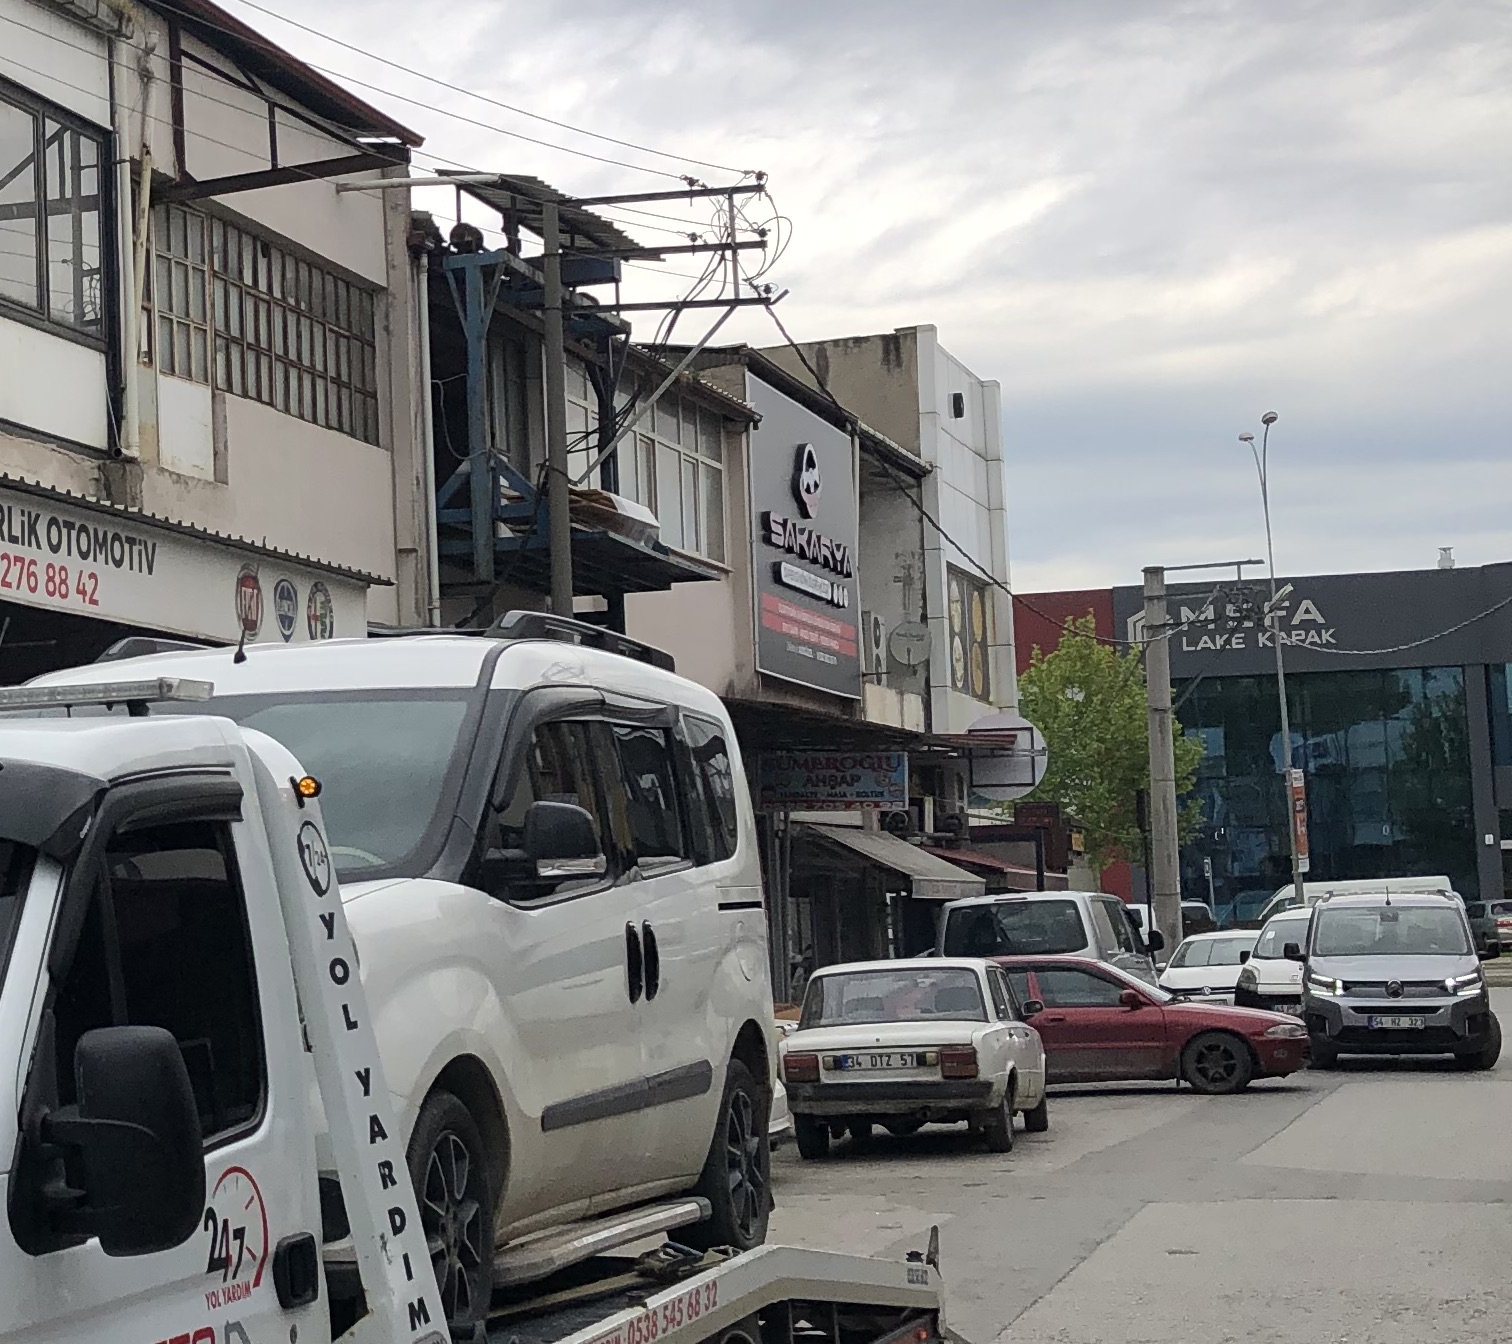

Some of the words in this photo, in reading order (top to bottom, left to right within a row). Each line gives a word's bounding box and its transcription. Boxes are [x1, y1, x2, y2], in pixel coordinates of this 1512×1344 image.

[768, 511, 852, 577] SAKARYA
[1, 553, 38, 594] 276
[45, 563, 69, 599] 88
[75, 572, 99, 607] 42
[1182, 633, 1245, 651] LAKE
[1258, 628, 1337, 647] KAPAK
[849, 1056, 862, 1069] 34
[900, 1053, 914, 1066] 57
[319, 911, 358, 1031] YOL
[354, 1067, 431, 1332] YARDIM
[205, 1290, 221, 1310] YOL
[222, 1281, 252, 1305] YARDIM
[662, 1297, 683, 1334] 545
[688, 1288, 701, 1320] 68
[704, 1280, 717, 1311] 32
